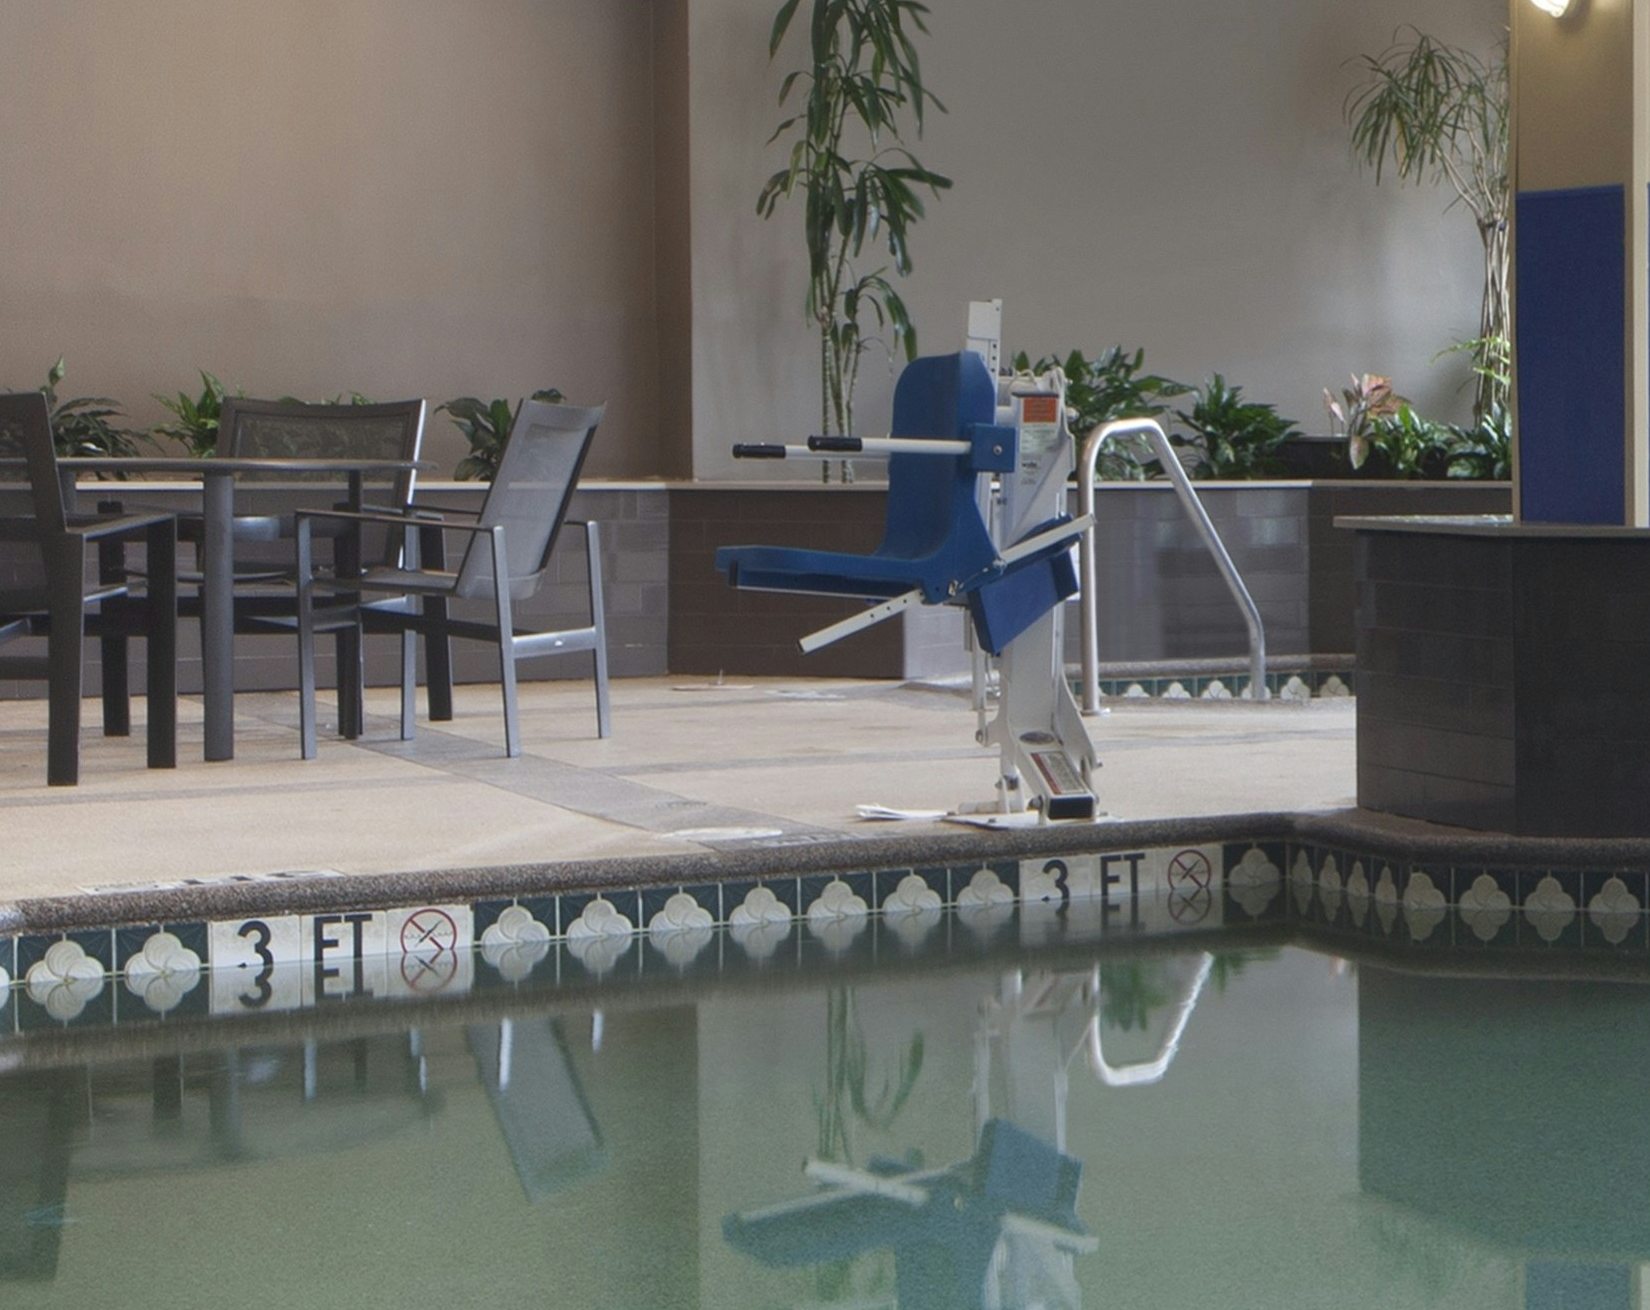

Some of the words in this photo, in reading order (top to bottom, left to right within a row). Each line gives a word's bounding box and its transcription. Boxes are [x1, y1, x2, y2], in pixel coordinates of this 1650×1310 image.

[1101, 852, 1145, 898] FT
[238, 920, 274, 968] 3
[314, 913, 373, 962] FT
